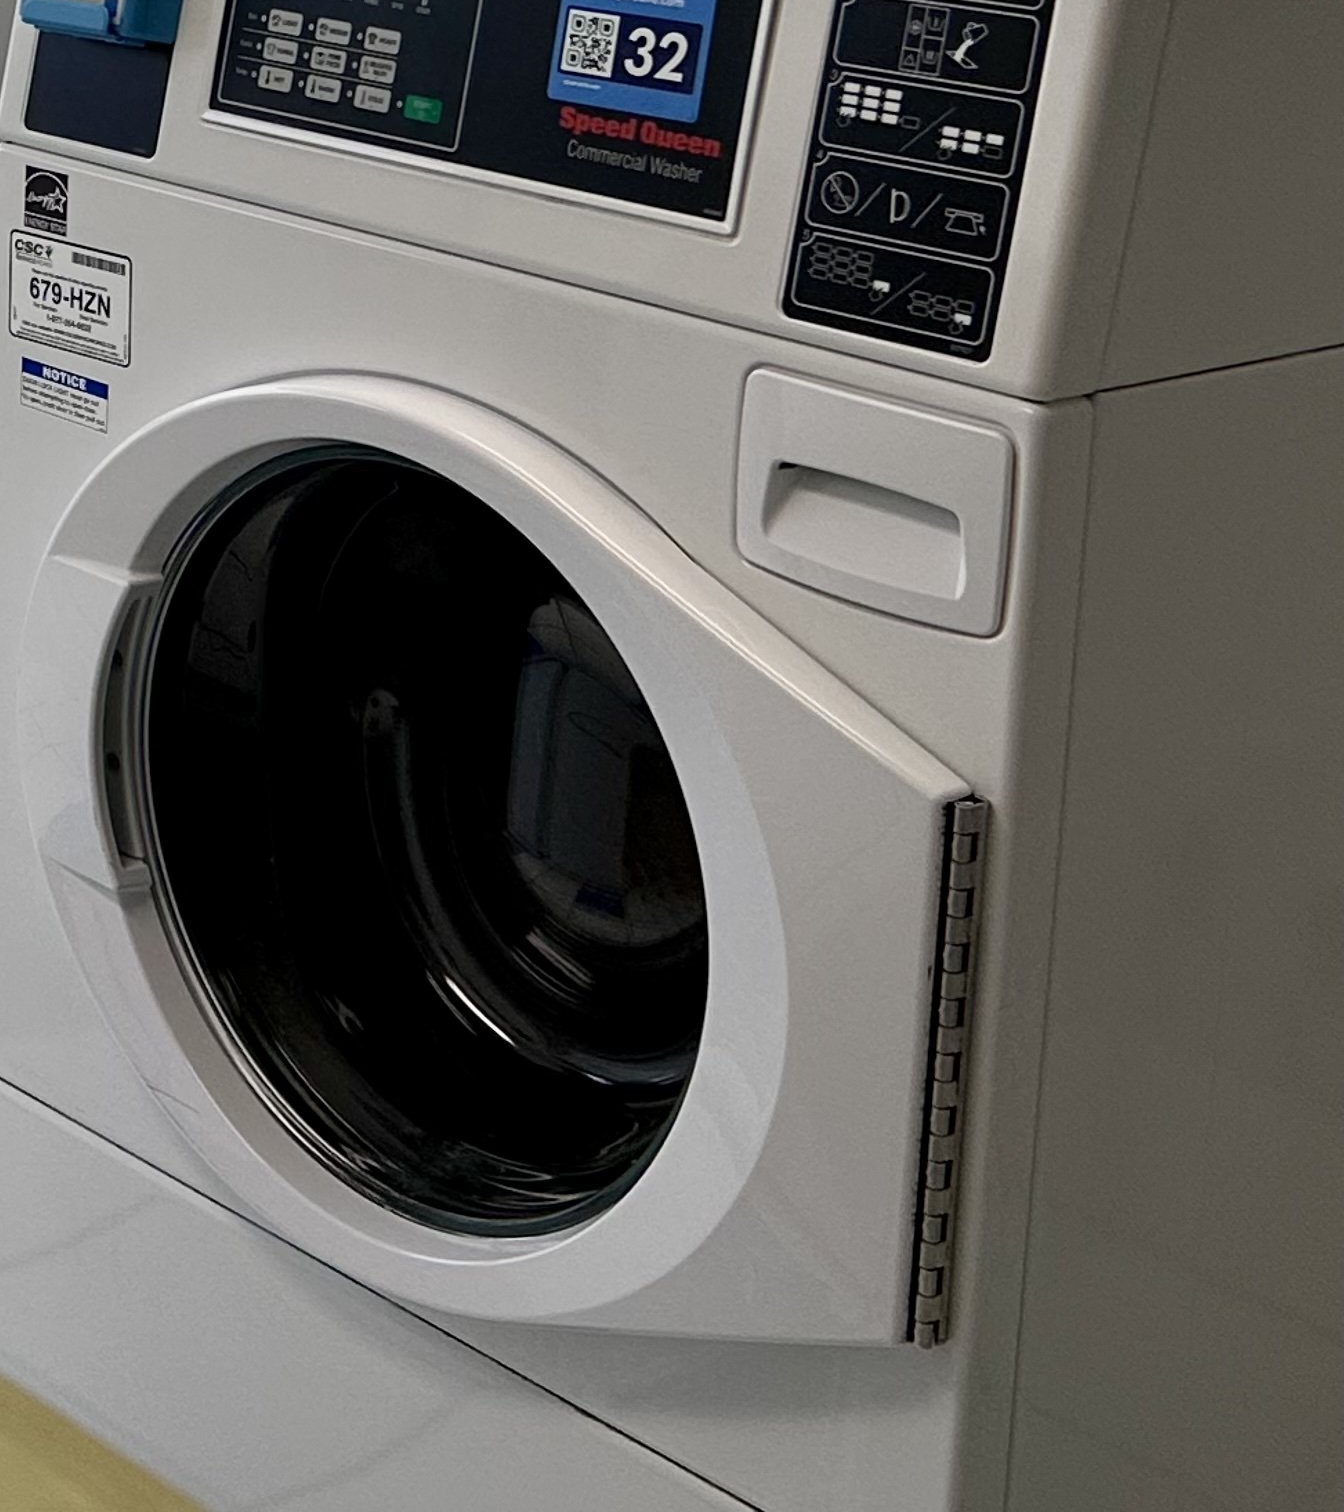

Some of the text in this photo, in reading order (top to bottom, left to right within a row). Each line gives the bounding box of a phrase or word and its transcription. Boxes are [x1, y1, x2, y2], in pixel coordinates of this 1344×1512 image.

[624, 27, 688, 83] 32
[559, 106, 721, 158] Speed Queen
[567, 139, 703, 183] Commercial Washer
[15, 239, 44, 255] CSC
[29, 277, 111, 319] 679-HZN
[42, 366, 87, 391] NOTICE
